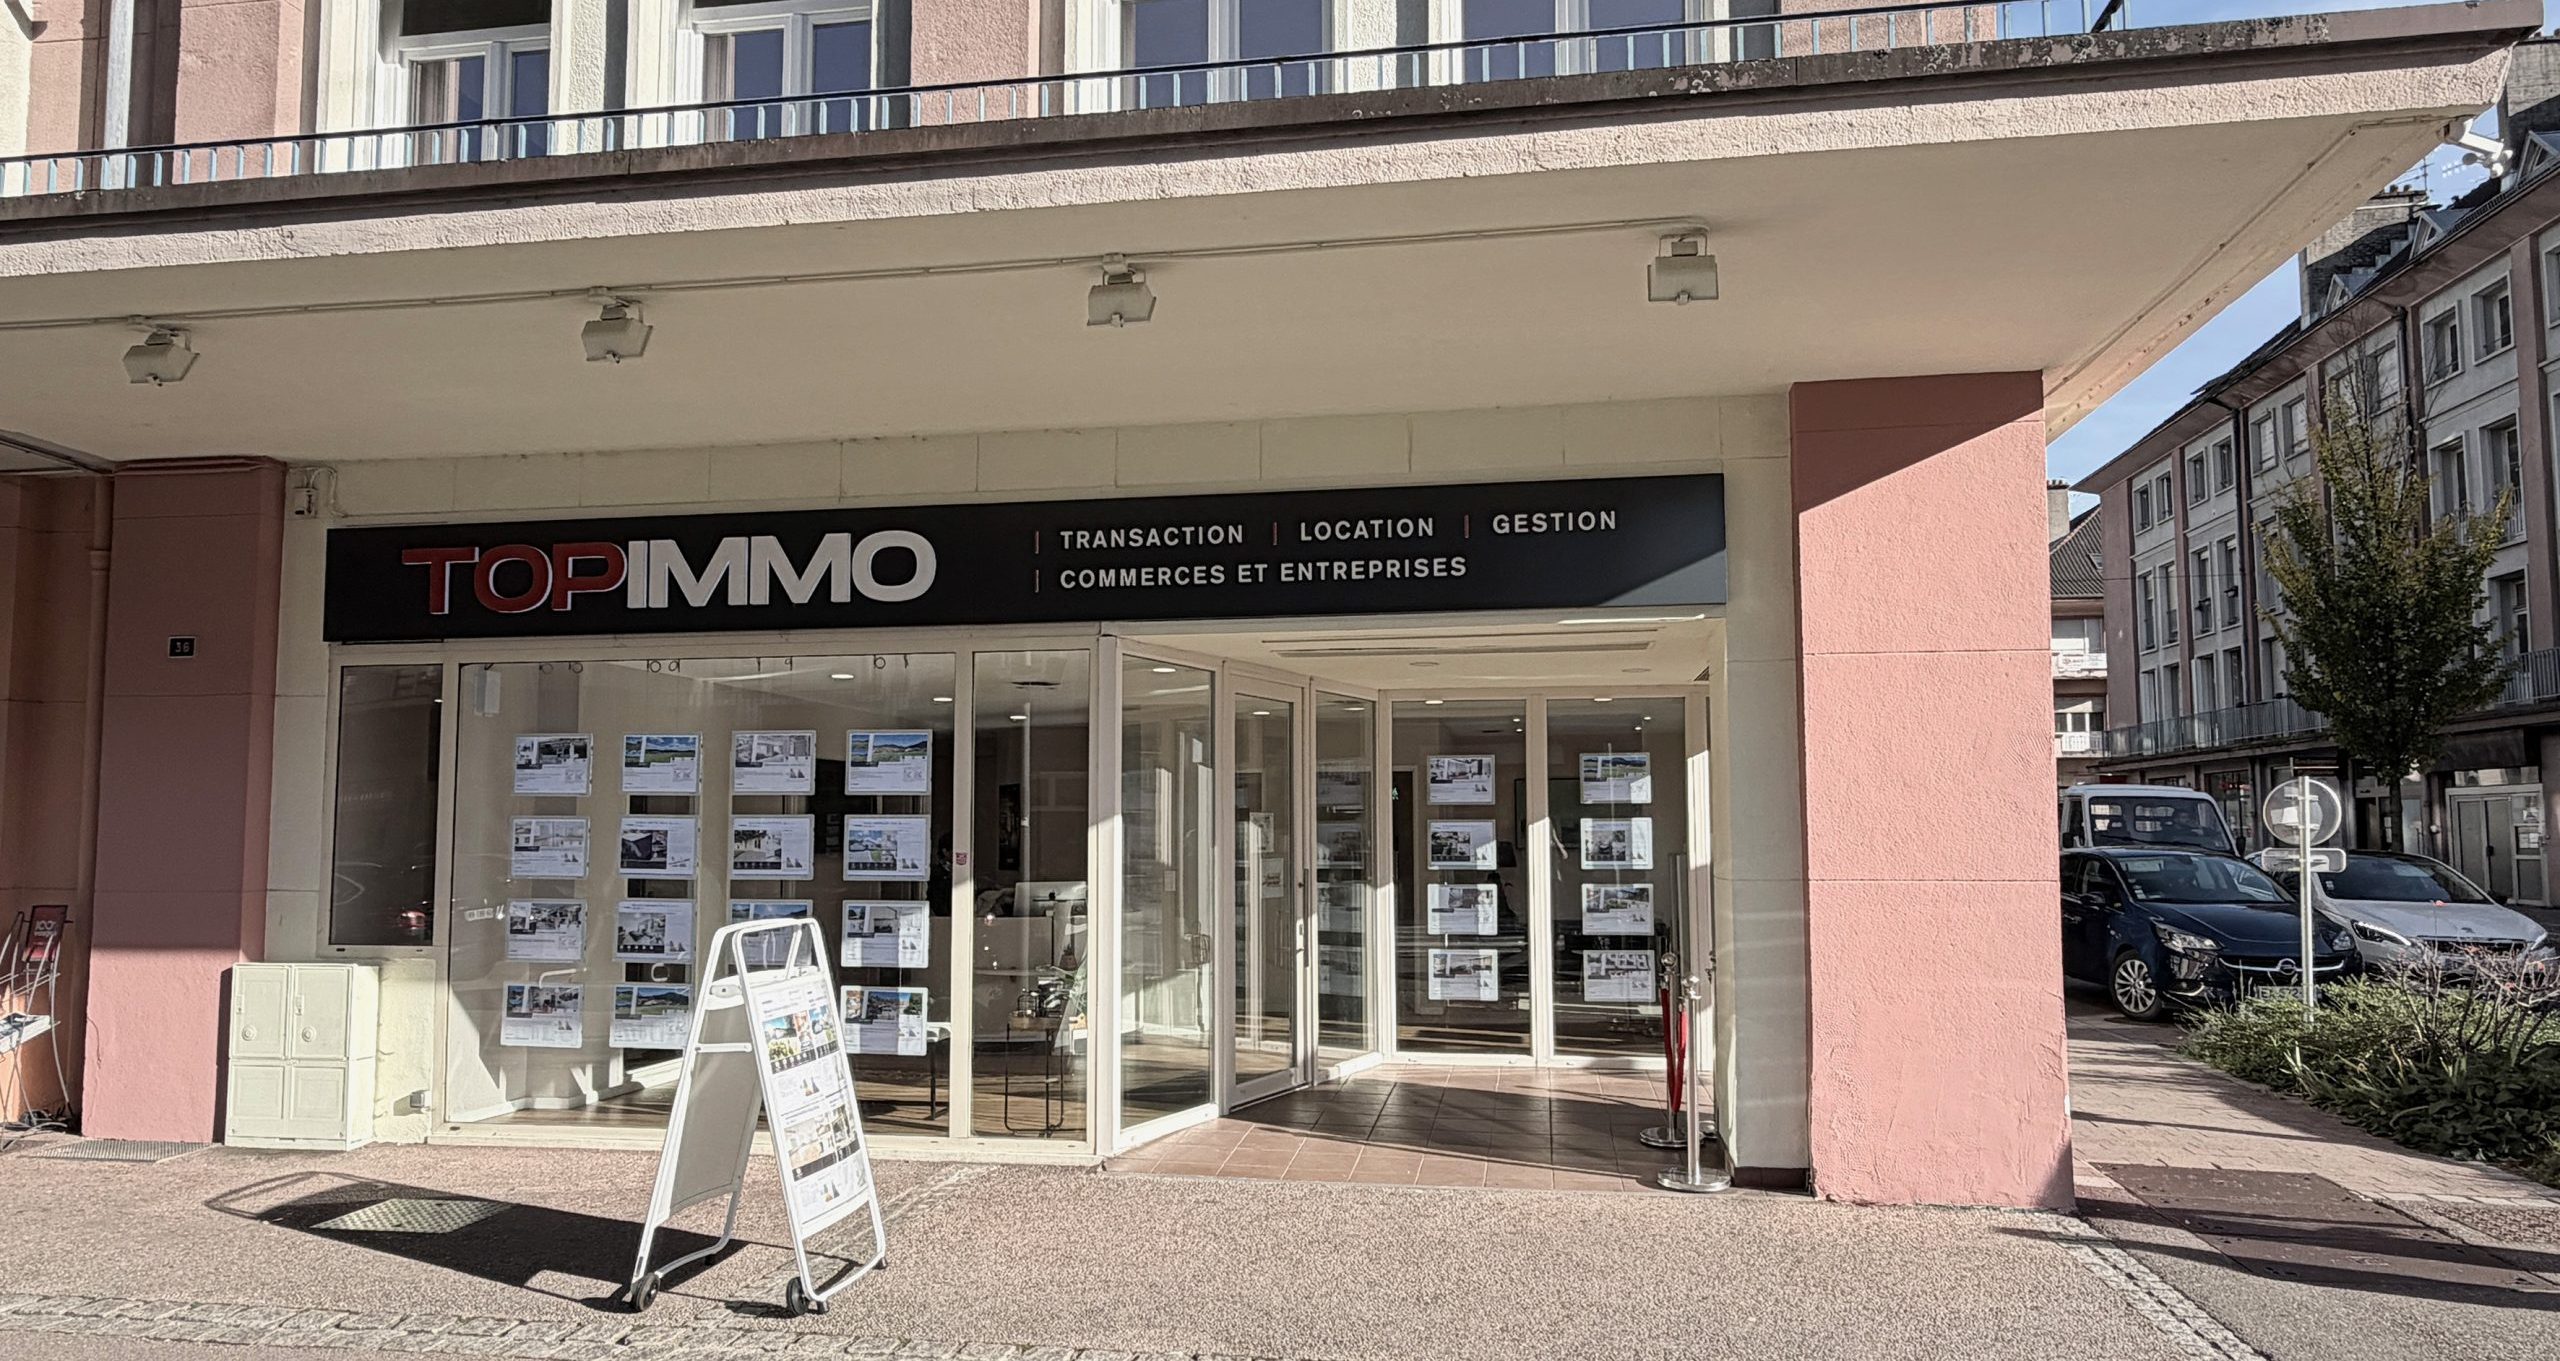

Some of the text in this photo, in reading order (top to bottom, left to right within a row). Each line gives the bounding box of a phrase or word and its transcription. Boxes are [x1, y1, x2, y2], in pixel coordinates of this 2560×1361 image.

[1060, 510, 1616, 550] TRANSACTION LOCATION GESTION
[401, 529, 937, 615] TOPIMMO
[1060, 556, 1467, 590] COMMERCES ET ENTREPRISES
